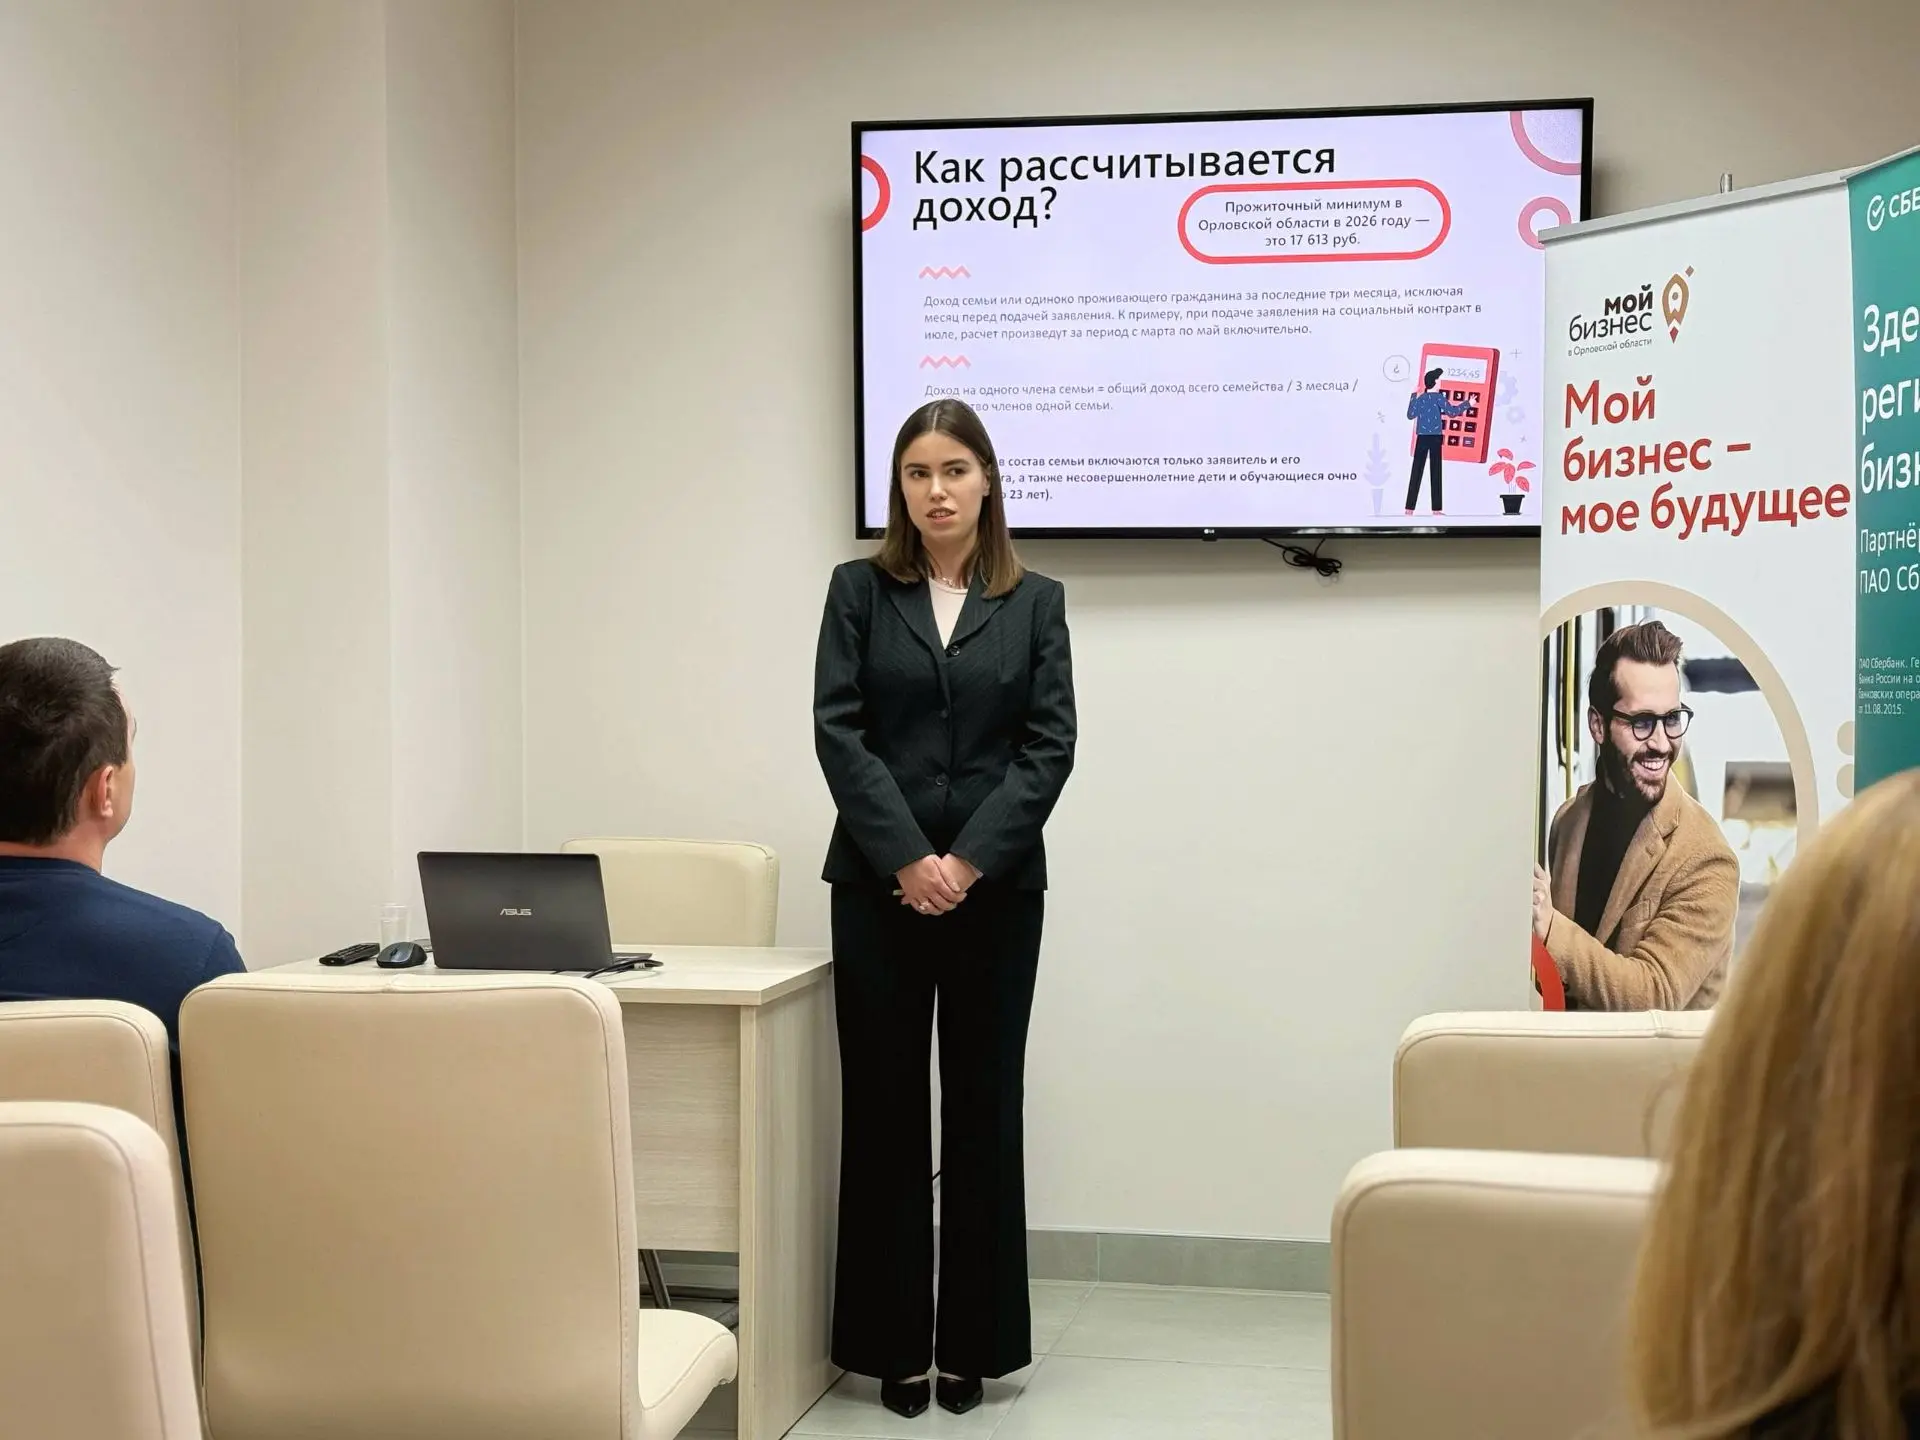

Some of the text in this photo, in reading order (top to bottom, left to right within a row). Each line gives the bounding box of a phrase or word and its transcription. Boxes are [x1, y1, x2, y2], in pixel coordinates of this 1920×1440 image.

[915, 148, 1335, 192] Как рассчитывается
[912, 186, 1058, 230] доход?
[1225, 199, 1403, 215] Прожиточный минимум в
[1198, 218, 1272, 233] Орловской
[1276, 216, 1329, 229] области
[1334, 218, 1341, 228] в
[1345, 215, 1378, 227] 2026
[1381, 217, 1412, 230] году
[1265, 233, 1361, 248] это 17 613 руб.
[923, 287, 1463, 309] Доход семьи или одиноко проживающего гражданина за последние три месяца, исключая
[1604, 283, 1653, 316] мой
[924, 313, 960, 324] месяц
[962, 311, 997, 325] перед
[999, 309, 1048, 324] подачей
[1051, 311, 1115, 321] заявления.
[1128, 310, 1183, 322] примеру,
[1186, 309, 1208, 321] при
[1211, 308, 1254, 320] подаче
[1256, 307, 1319, 318] заявления
[1322, 307, 1336, 316] на
[1339, 303, 1414, 317] социальный
[1417, 304, 1472, 316] контракт
[924, 331, 958, 341] июле,
[960, 328, 999, 341] расчет
[1001, 328, 1068, 341] произведут
[1070, 329, 1082, 338] за
[1086, 327, 1129, 339] период
[1140, 327, 1176, 339] марта
[1179, 327, 1194, 336] по
[1196, 324, 1220, 336] май
[1223, 324, 1313, 336] включительно.
[1569, 312, 1652, 342] бизнес
[1863, 304, 1920, 357] Зде
[1567, 338, 1652, 357] в Орловской области
[924, 384, 960, 396] Доход
[962, 386, 976, 396] на
[979, 386, 1021, 397] одного
[1023, 385, 1055, 394] члена
[1058, 385, 1094, 395] семьи
[1107, 381, 1147, 396] общий
[1149, 383, 1186, 395] доход
[1188, 383, 1220, 393] всего
[1222, 380, 1284, 392] семейства
[1305, 381, 1349, 392] месяца
[991, 402, 1032, 411] членов
[1035, 399, 1072, 413] одной
[1074, 401, 1113, 410] семьи.
[1565, 374, 1656, 428] Мой
[1008, 458, 1045, 467] состав
[1048, 457, 1085, 466] семьи
[1087, 456, 1160, 466] включаются
[1162, 456, 1204, 466] только
[1206, 456, 1267, 465] заявитель
[1281, 456, 1301, 465] его
[1563, 436, 1713, 482] бизнес
[1027, 474, 1063, 483] также
[1066, 473, 1195, 485] несовершеннолетние
[1197, 473, 1226, 483] дети
[1239, 470, 1324, 483] обучающиеся
[1327, 472, 1357, 481] очно
[1009, 488, 1023, 500] 23
[1026, 488, 1053, 502] лет).
[1561, 481, 1851, 541] мое будущее
[1860, 521, 1920, 557] Партнё
[1860, 567, 1890, 595] ПАО
[499, 908, 532, 916] ASUS
